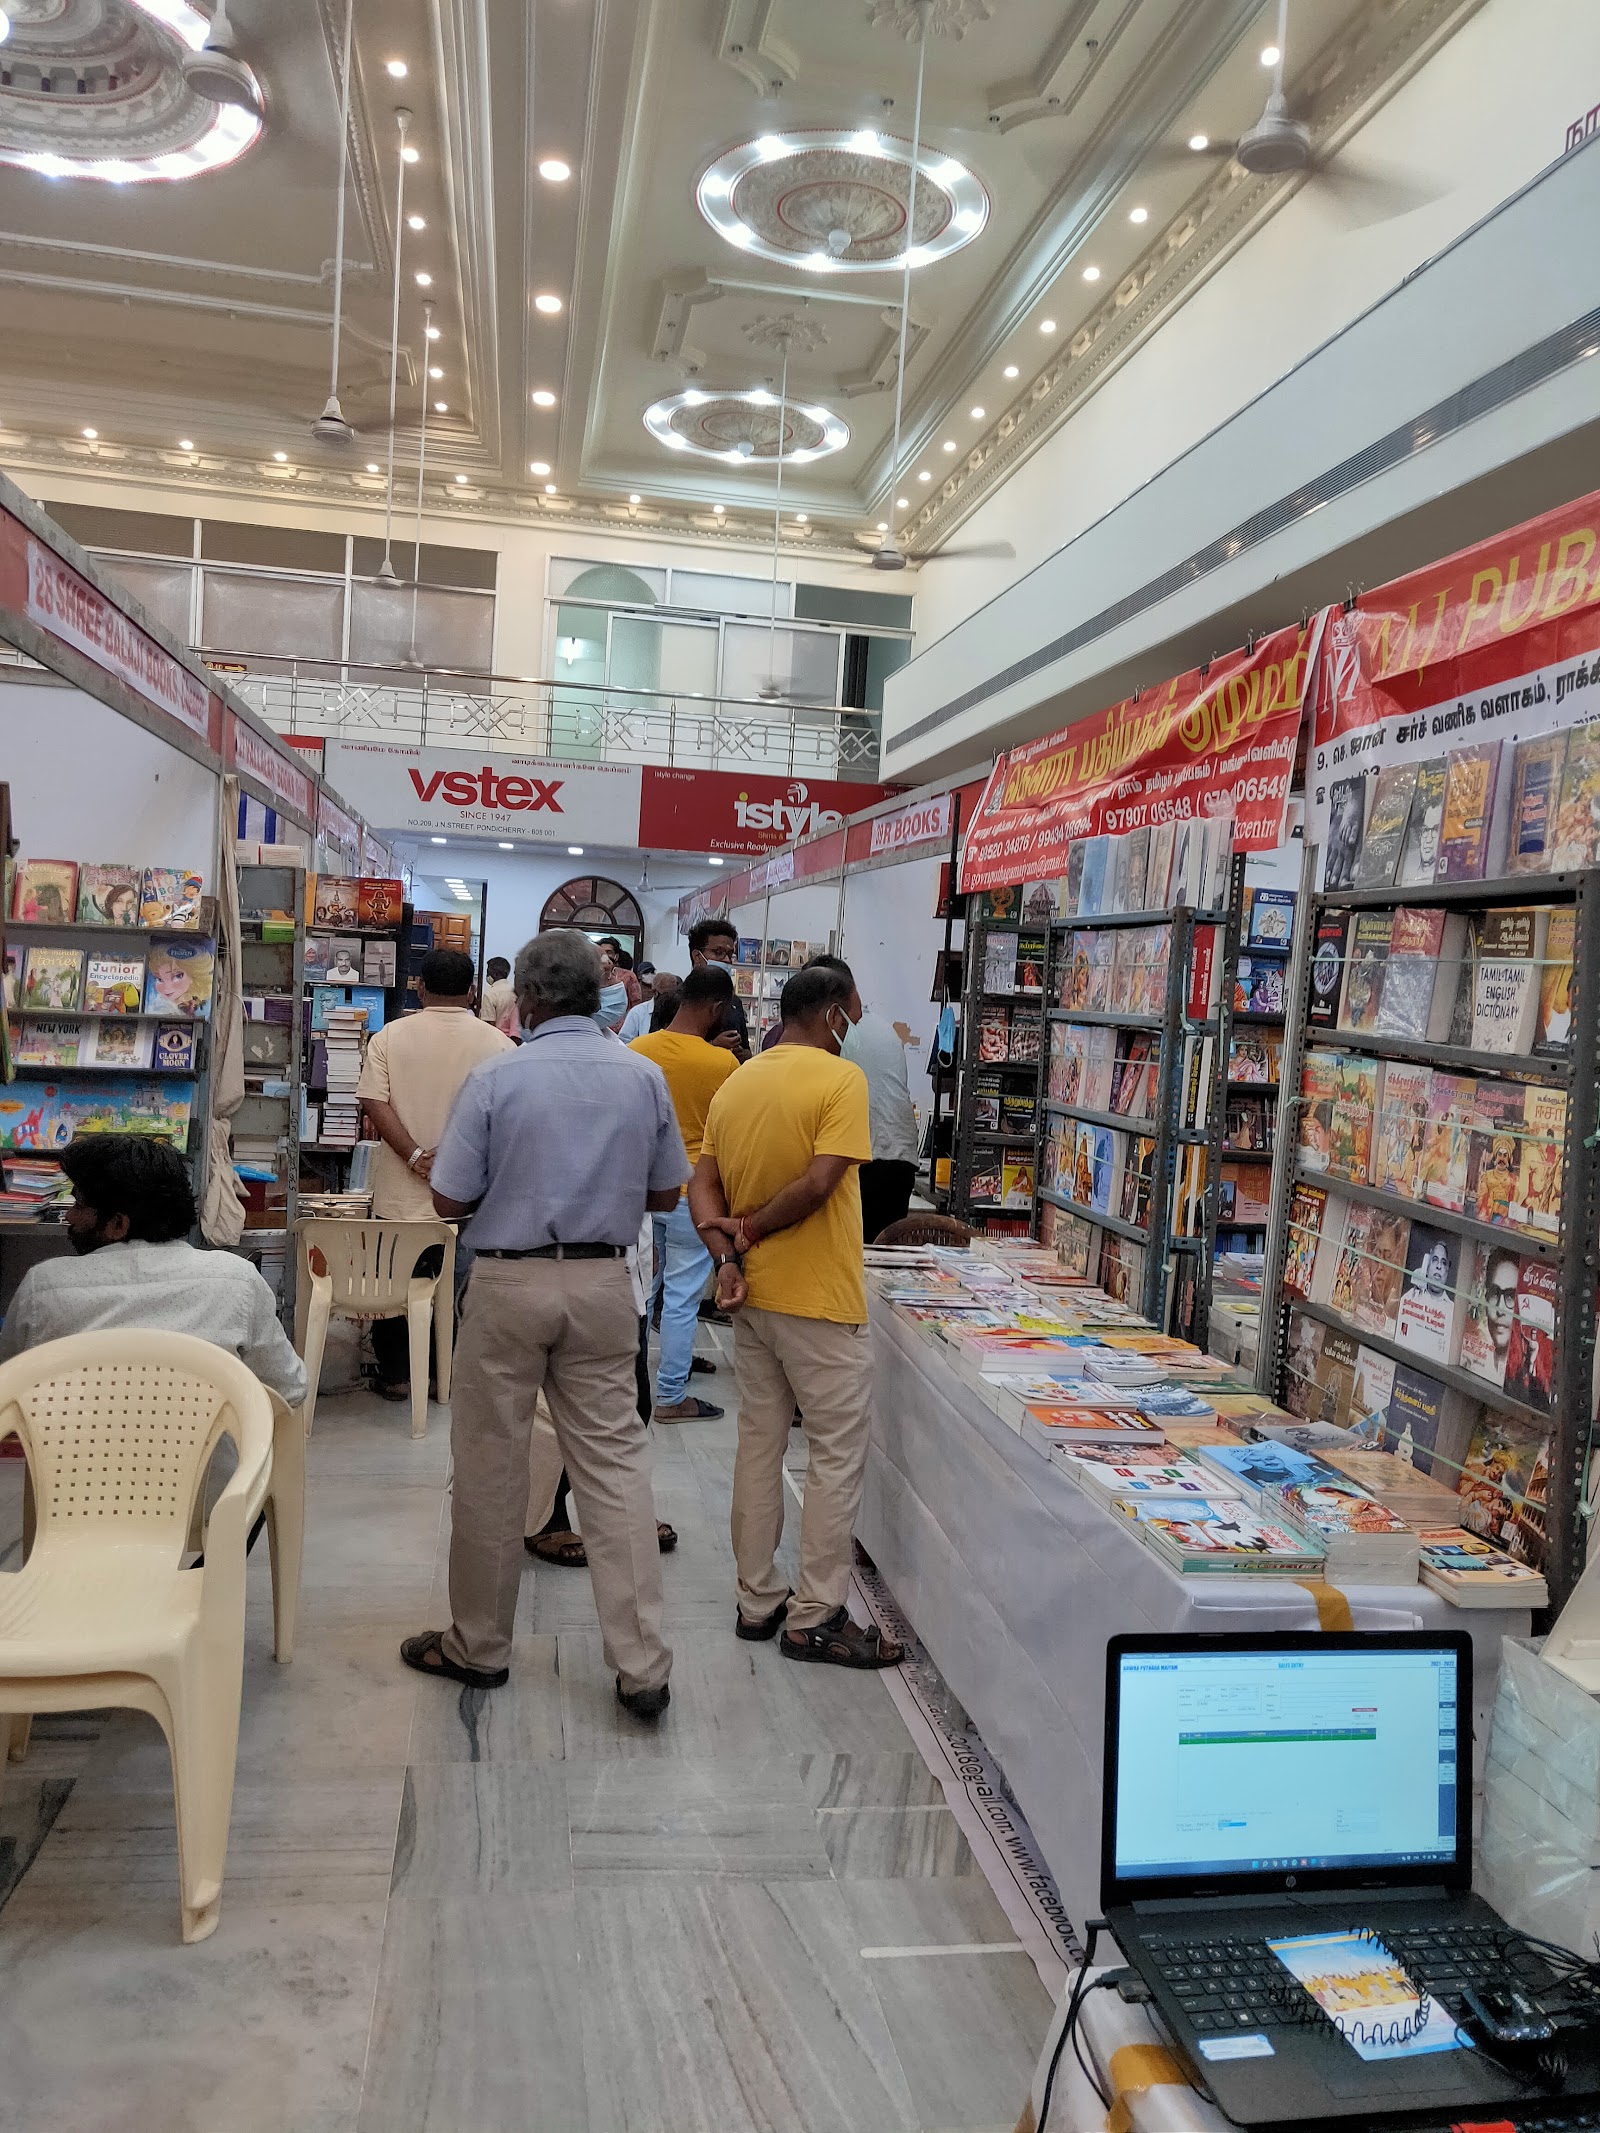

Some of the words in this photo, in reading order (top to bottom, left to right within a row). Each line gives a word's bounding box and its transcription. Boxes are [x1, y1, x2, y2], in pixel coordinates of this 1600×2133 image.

[55, 567, 103, 649] SHREE
[1431, 701, 1476, 736] வணிக
[672, 773, 696, 782] change
[408, 766, 565, 813] vstex
[1105, 804, 1148, 831] 97907
[1150, 796, 1192, 824] 06548
[1236, 773, 1288, 803] 06549
[460, 811, 486, 820] SINCE
[490, 813, 511, 822] 1947
[710, 839, 745, 851] Exclusive
[30, 956, 78, 967] Stories
[93, 962, 139, 974] Junior
[89, 973, 140, 982] Encyclopedia
[1481, 967, 1526, 982] TAMIL-TAMIL
[1486, 986, 1516, 1001] ENGLISH
[1476, 1003, 1520, 1020] DICTIONARY
[36, 1022, 57, 1034] NEW
[58, 1023, 81, 1035] YORK
[159, 1052, 190, 1062] CLOVER
[162, 1059, 186, 1068] MOON
